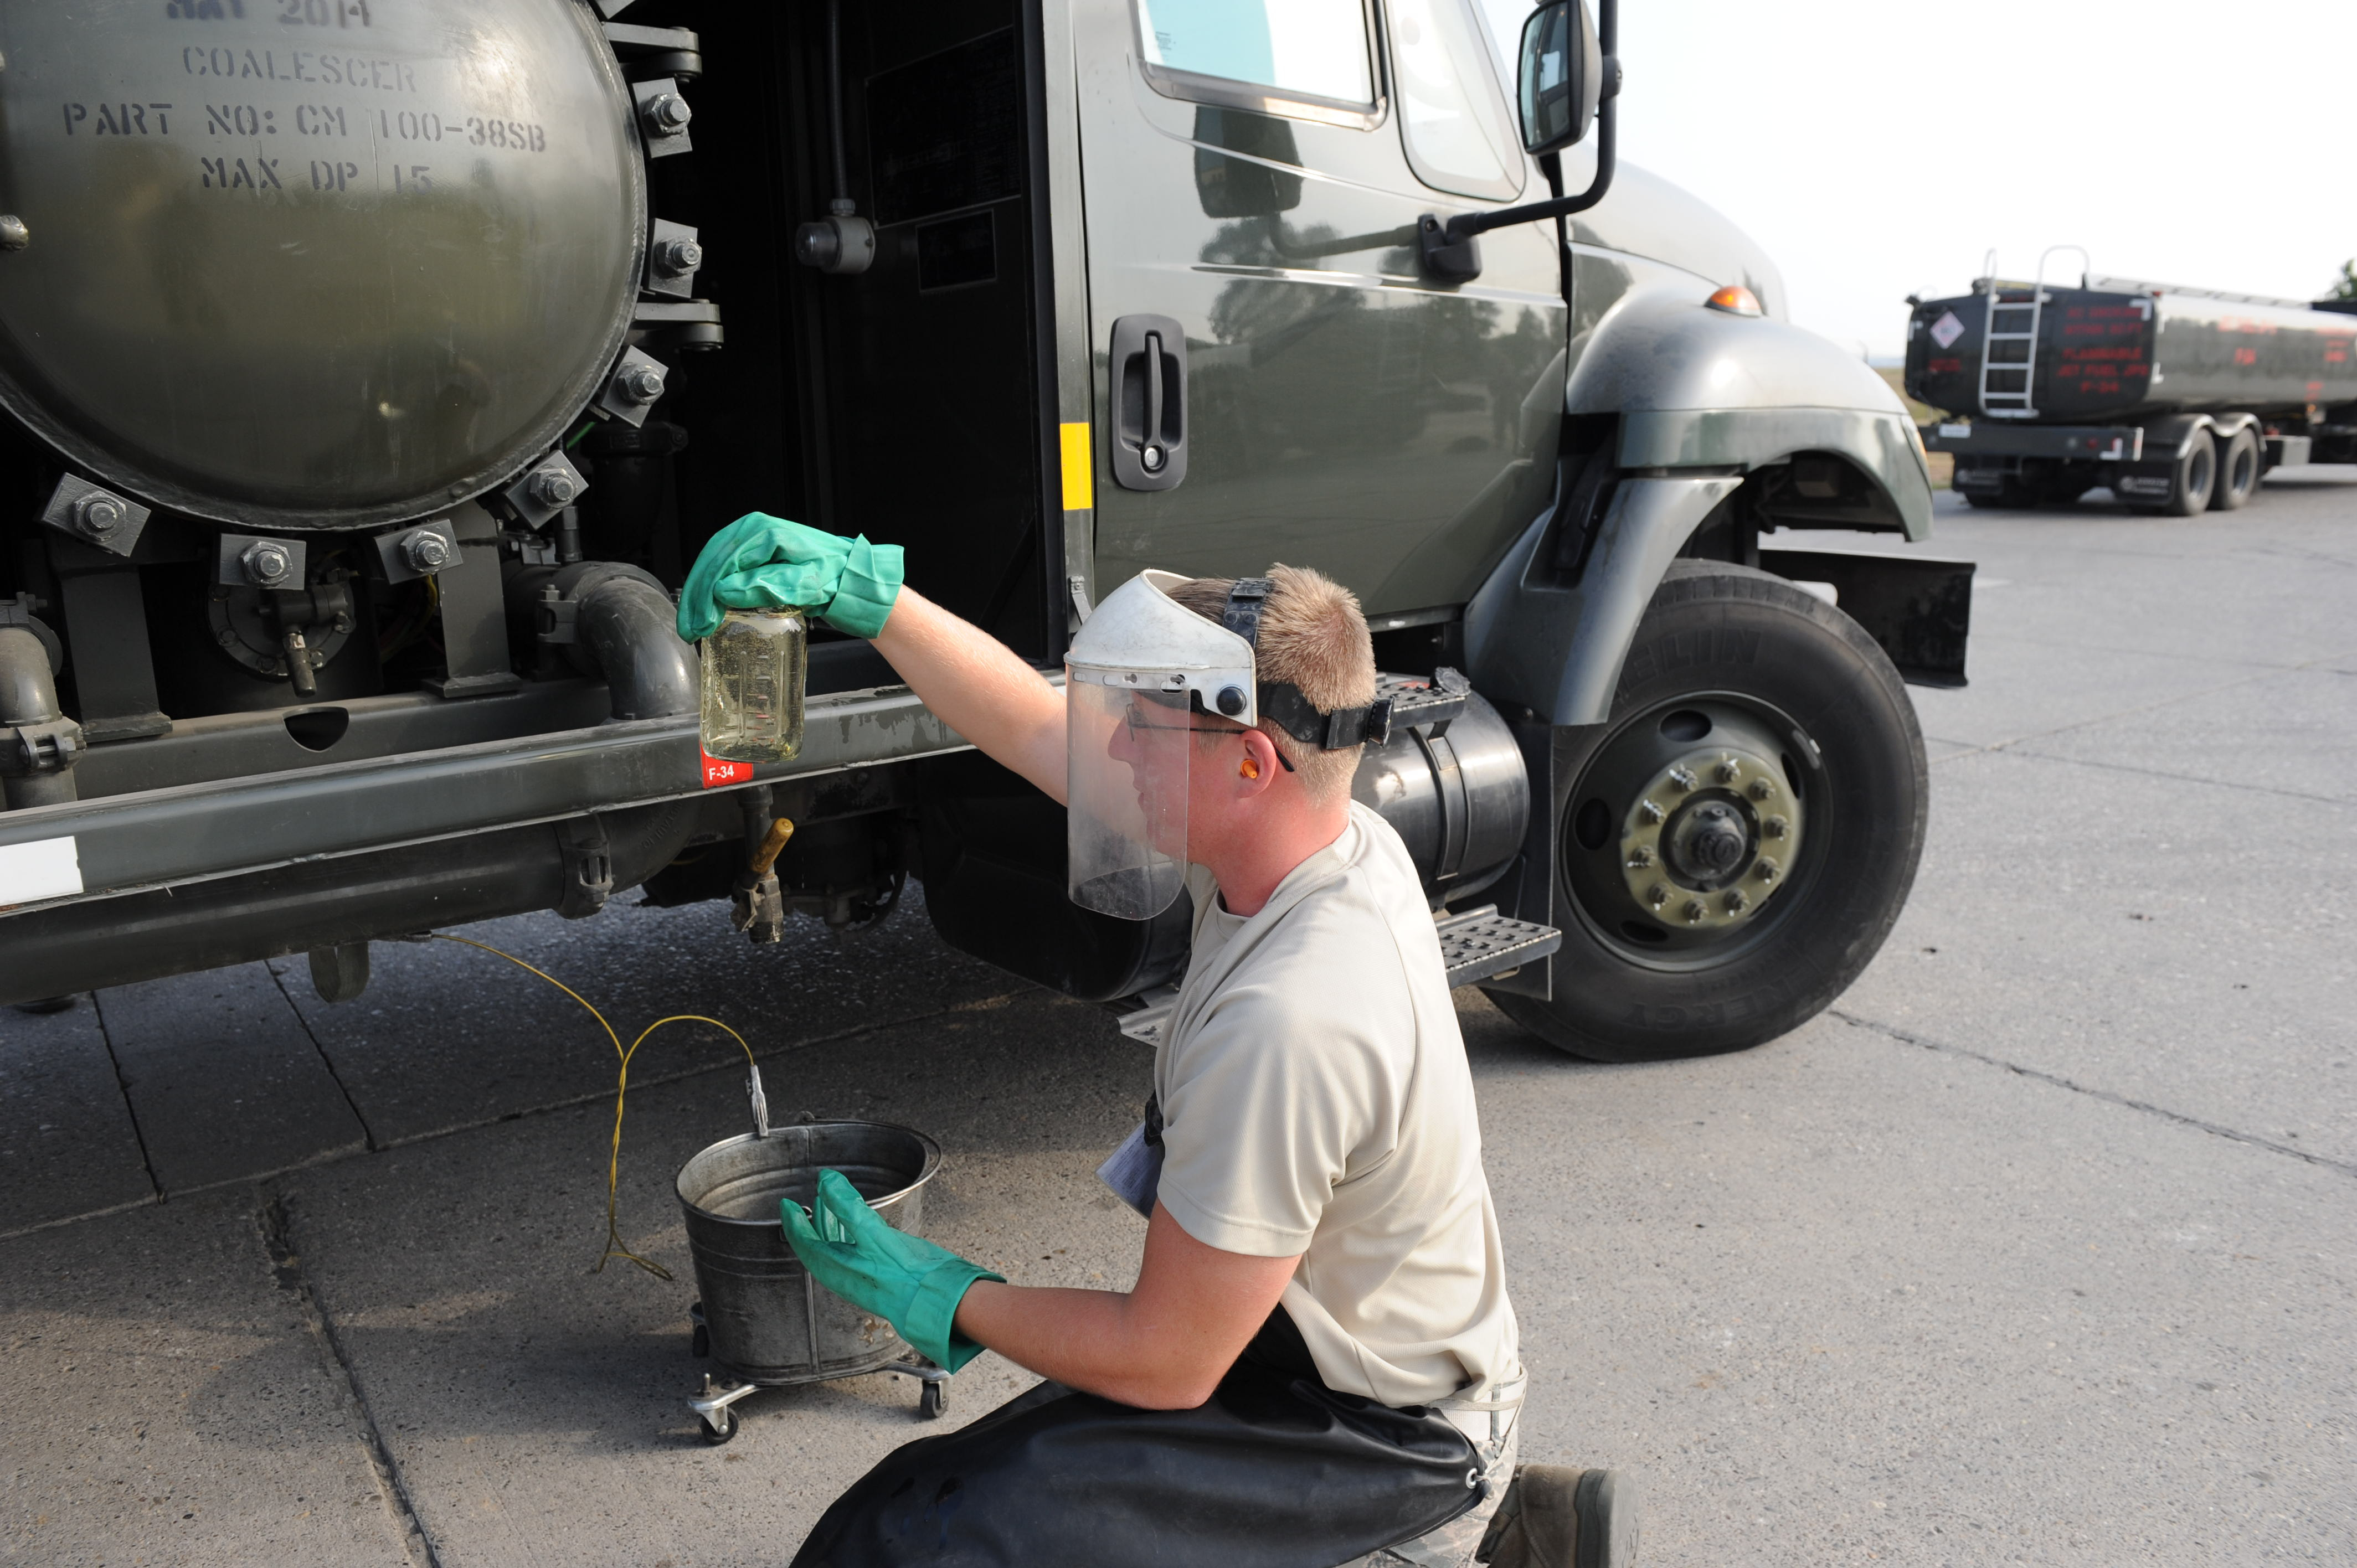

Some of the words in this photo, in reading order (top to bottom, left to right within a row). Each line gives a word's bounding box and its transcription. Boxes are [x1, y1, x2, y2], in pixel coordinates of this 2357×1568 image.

[277, 0, 370, 29] 2014
[183, 47, 417, 93] COALESCER
[62, 103, 173, 135] PART
[205, 105, 277, 136] NO:
[296, 105, 347, 136] CM
[201, 157, 282, 189] MAX
[310, 160, 358, 192] DP
[394, 164, 433, 195] 15
[708, 764, 735, 781] F-34
